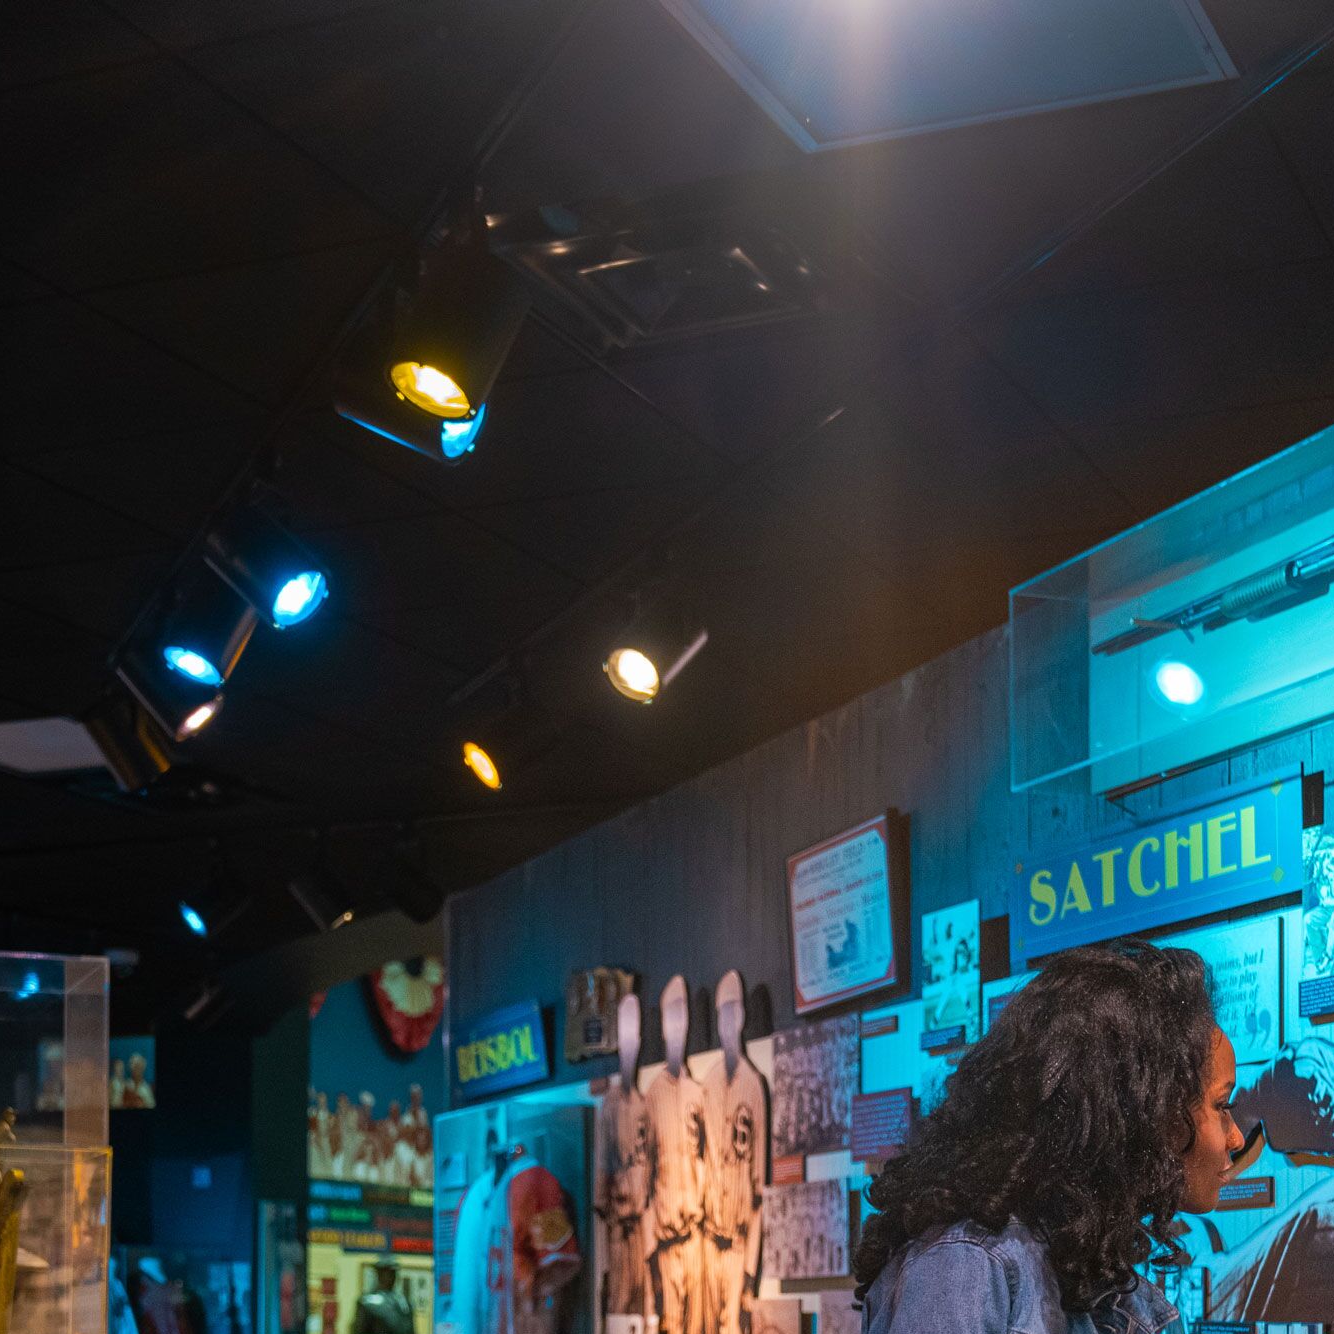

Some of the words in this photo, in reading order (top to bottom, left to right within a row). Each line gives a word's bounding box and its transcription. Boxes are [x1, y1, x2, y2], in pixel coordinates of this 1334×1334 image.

[1028, 806, 1273, 927] SATCHEL
[1244, 952, 1257, 967] but
[1260, 949, 1263, 963] I
[1239, 969, 1257, 989] play
